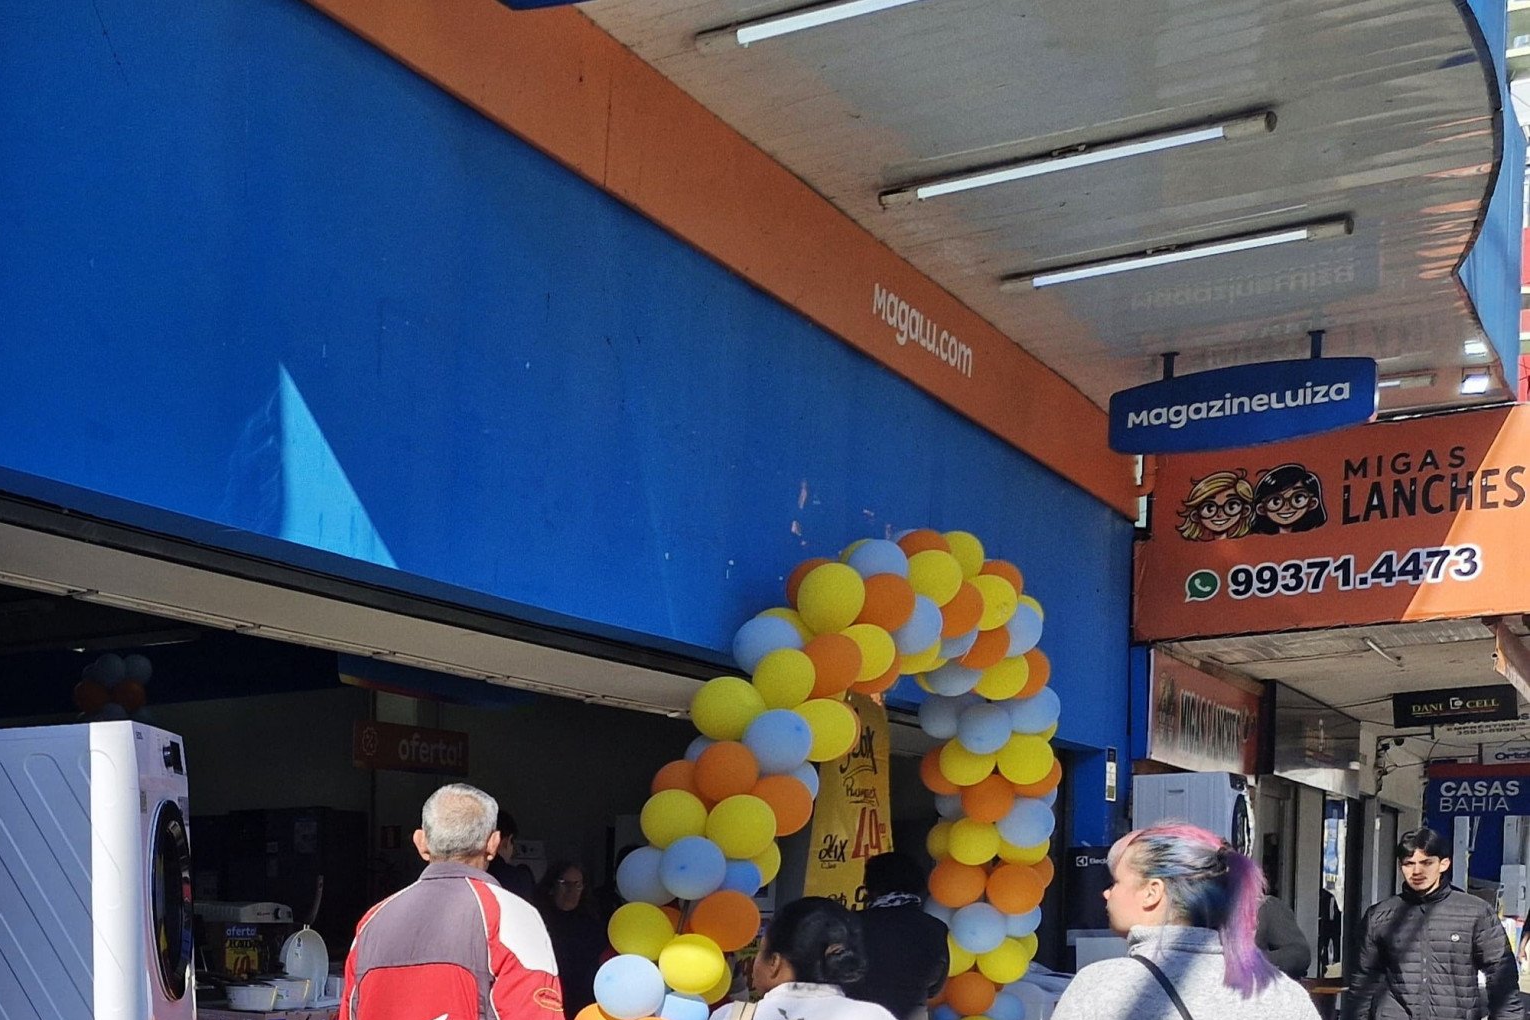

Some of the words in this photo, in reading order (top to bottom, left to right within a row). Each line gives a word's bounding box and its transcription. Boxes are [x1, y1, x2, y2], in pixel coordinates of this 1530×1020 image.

[1343, 446, 1466, 481] MIGAS
[1341, 465, 1526, 526] LANCHES
[1230, 547, 1480, 597] 99371.4473
[1412, 703, 1443, 713] DANI
[1466, 698, 1500, 708] CELL
[1440, 781, 1520, 797] CASAS
[1439, 797, 1510, 812] BAHIA
